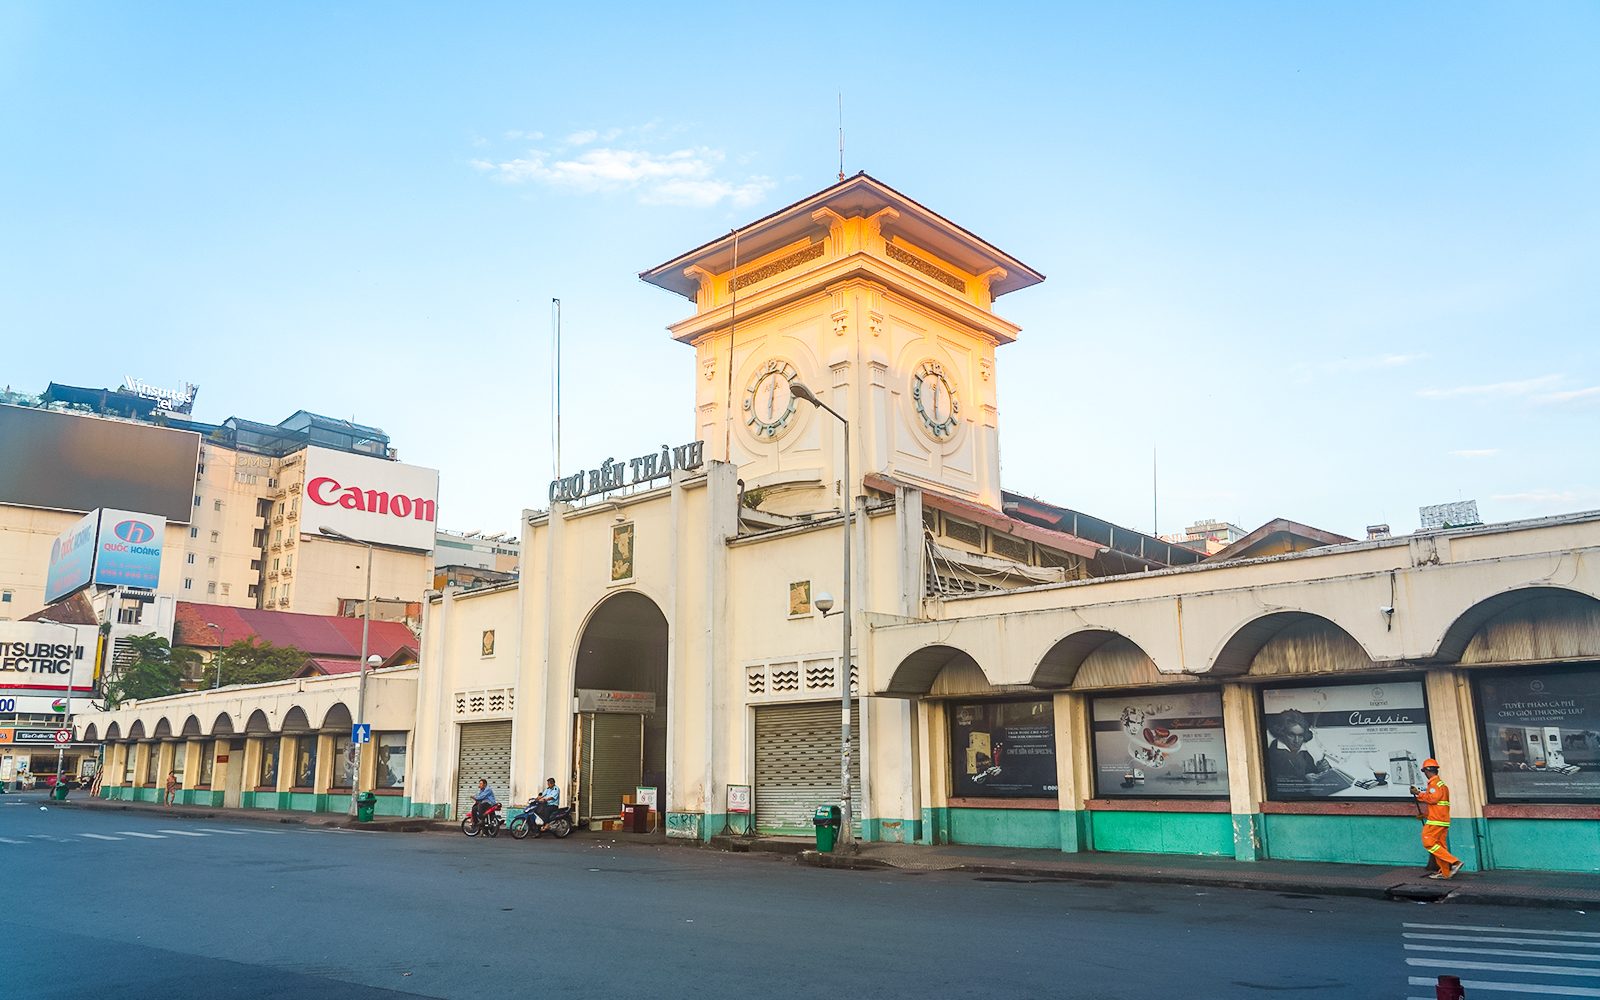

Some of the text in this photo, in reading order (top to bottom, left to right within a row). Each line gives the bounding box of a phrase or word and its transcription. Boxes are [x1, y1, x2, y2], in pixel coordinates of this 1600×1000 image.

[934, 424, 941, 436] 6
[588, 457, 626, 494] BẾN
[629, 440, 704, 484] THÀNH
[307, 476, 434, 522] Canon
[104, 541, 160, 557] QUỐC HOÀNG
[1349, 711, 1413, 726] Classic
